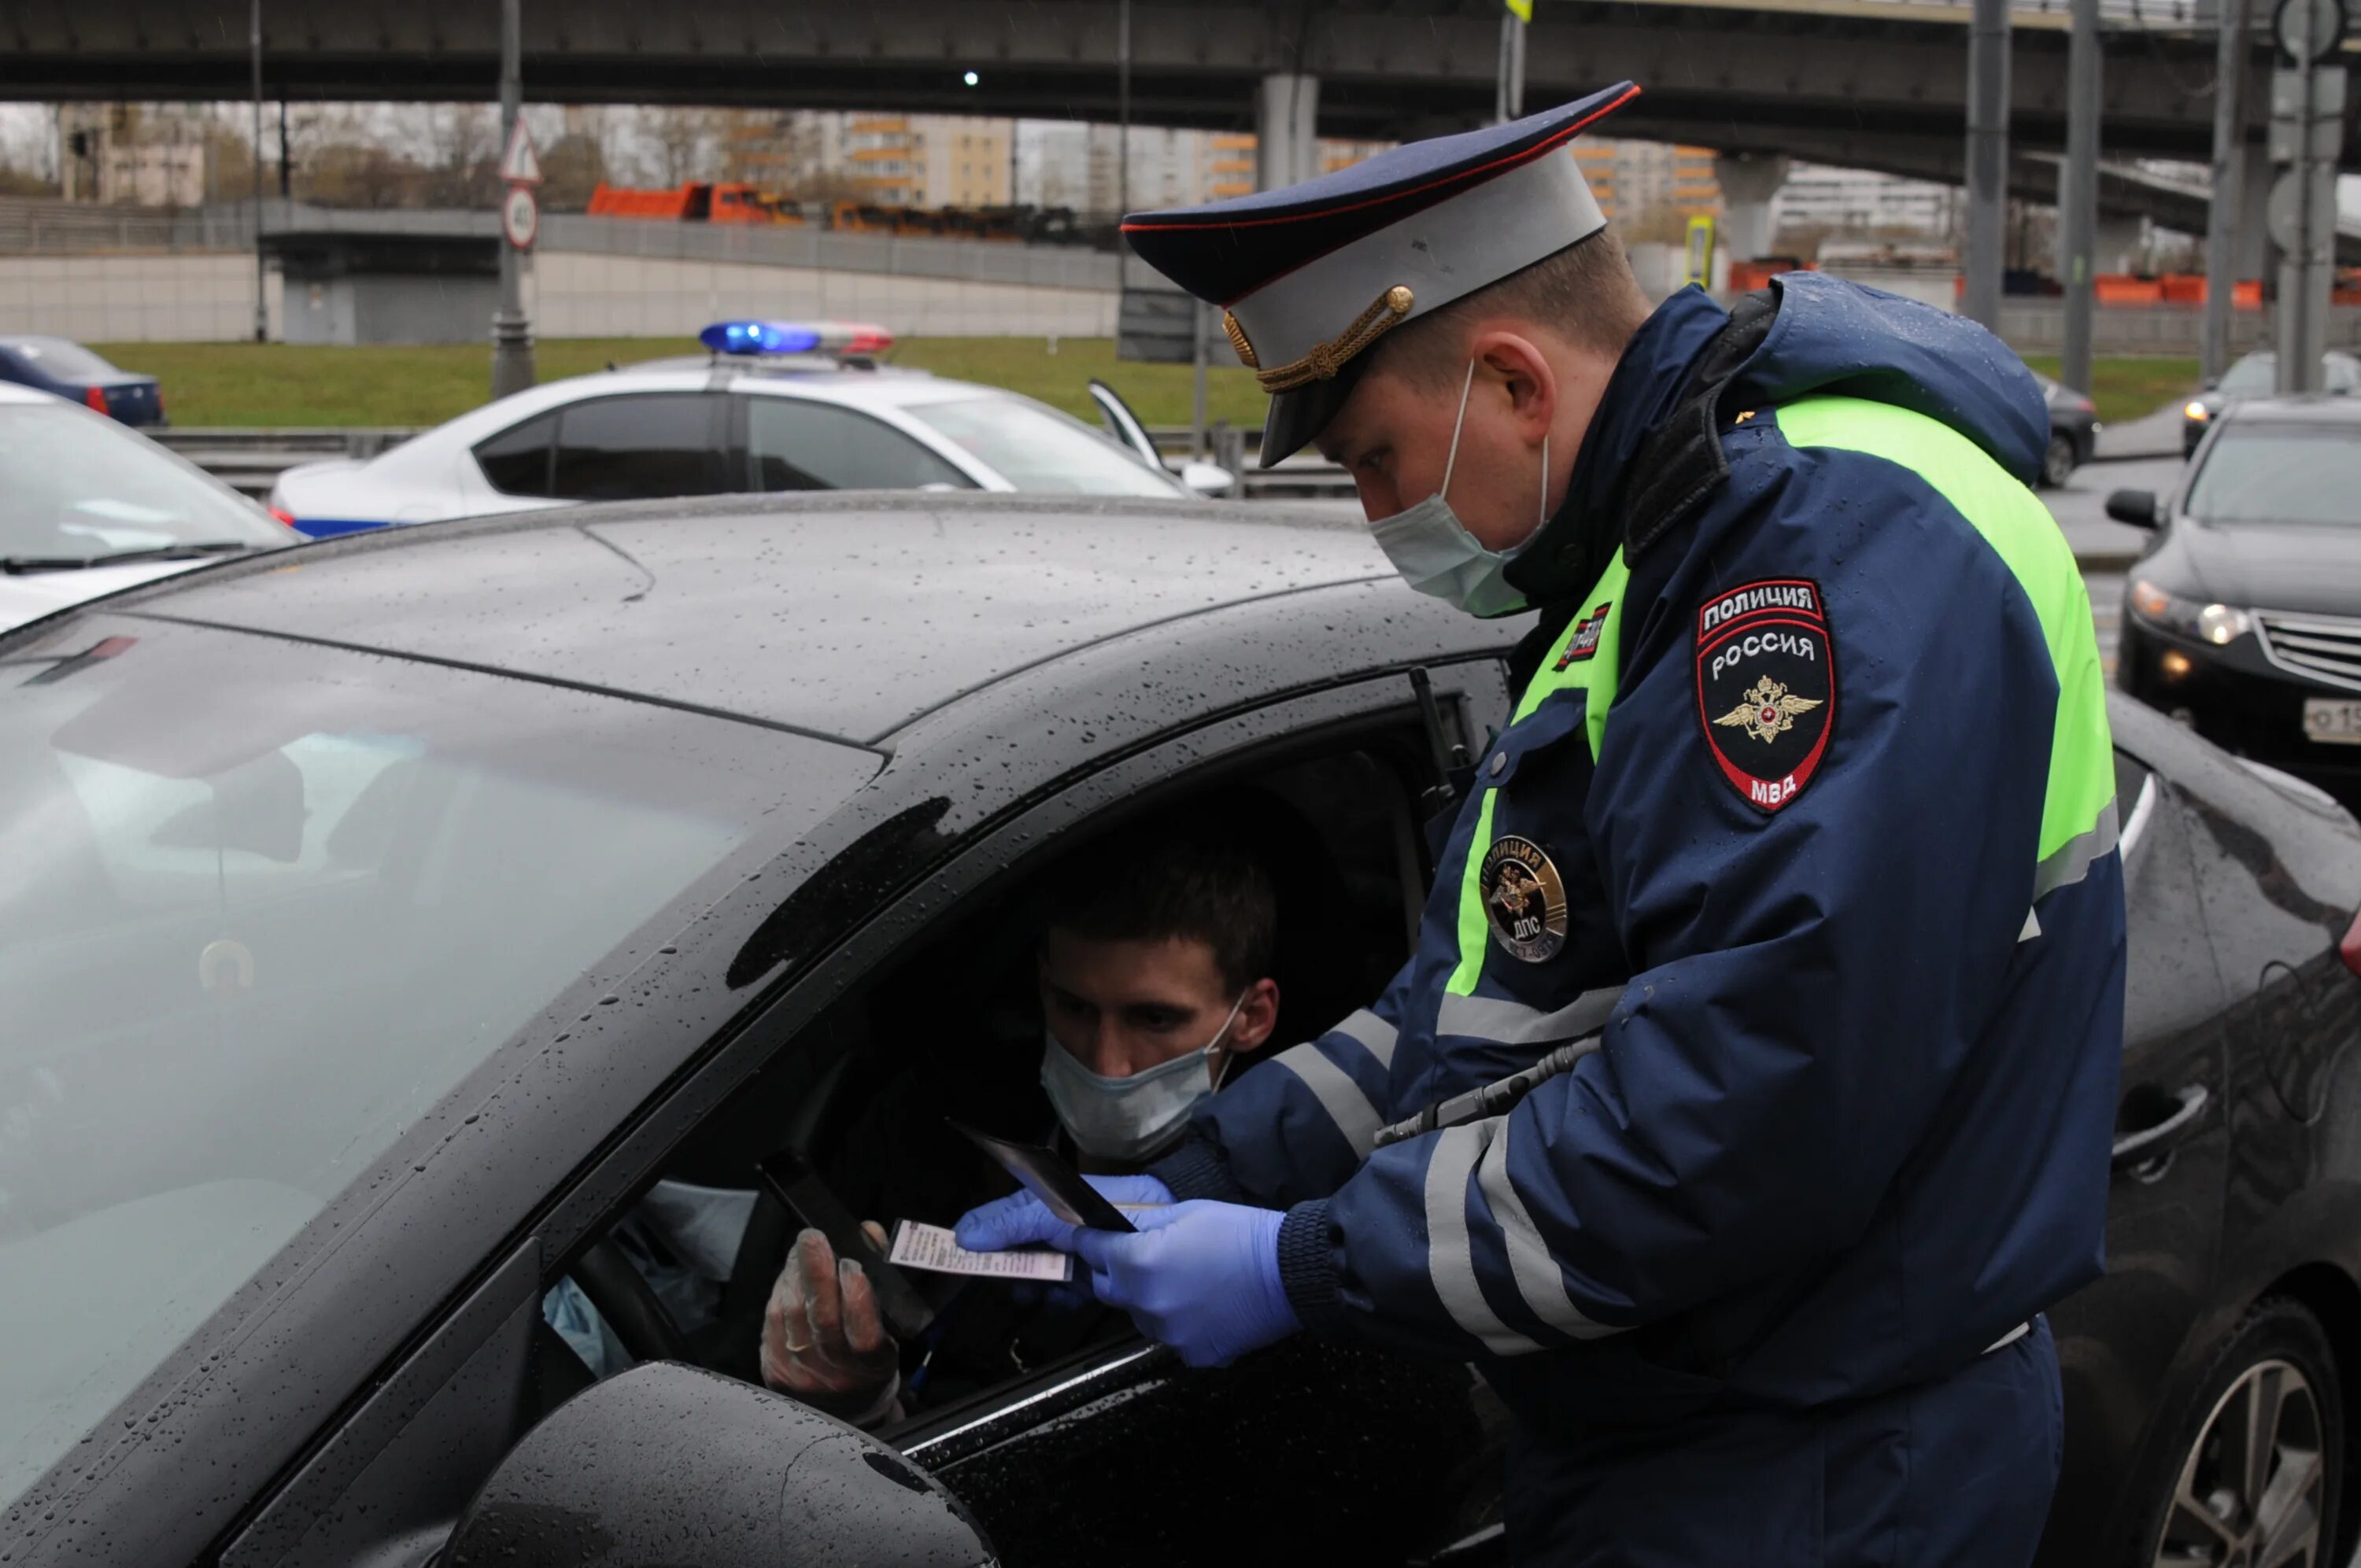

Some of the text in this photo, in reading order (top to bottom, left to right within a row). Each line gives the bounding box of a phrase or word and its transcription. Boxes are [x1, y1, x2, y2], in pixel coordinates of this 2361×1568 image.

[1703, 586, 1813, 631] ПОЛИЦИЯ
[1712, 632, 1815, 681] РОССИЯ
[1751, 773, 1796, 804] МВД
[1481, 840, 1542, 884] ПОЛИЦИЯ
[1513, 917, 1541, 940] ДПС
